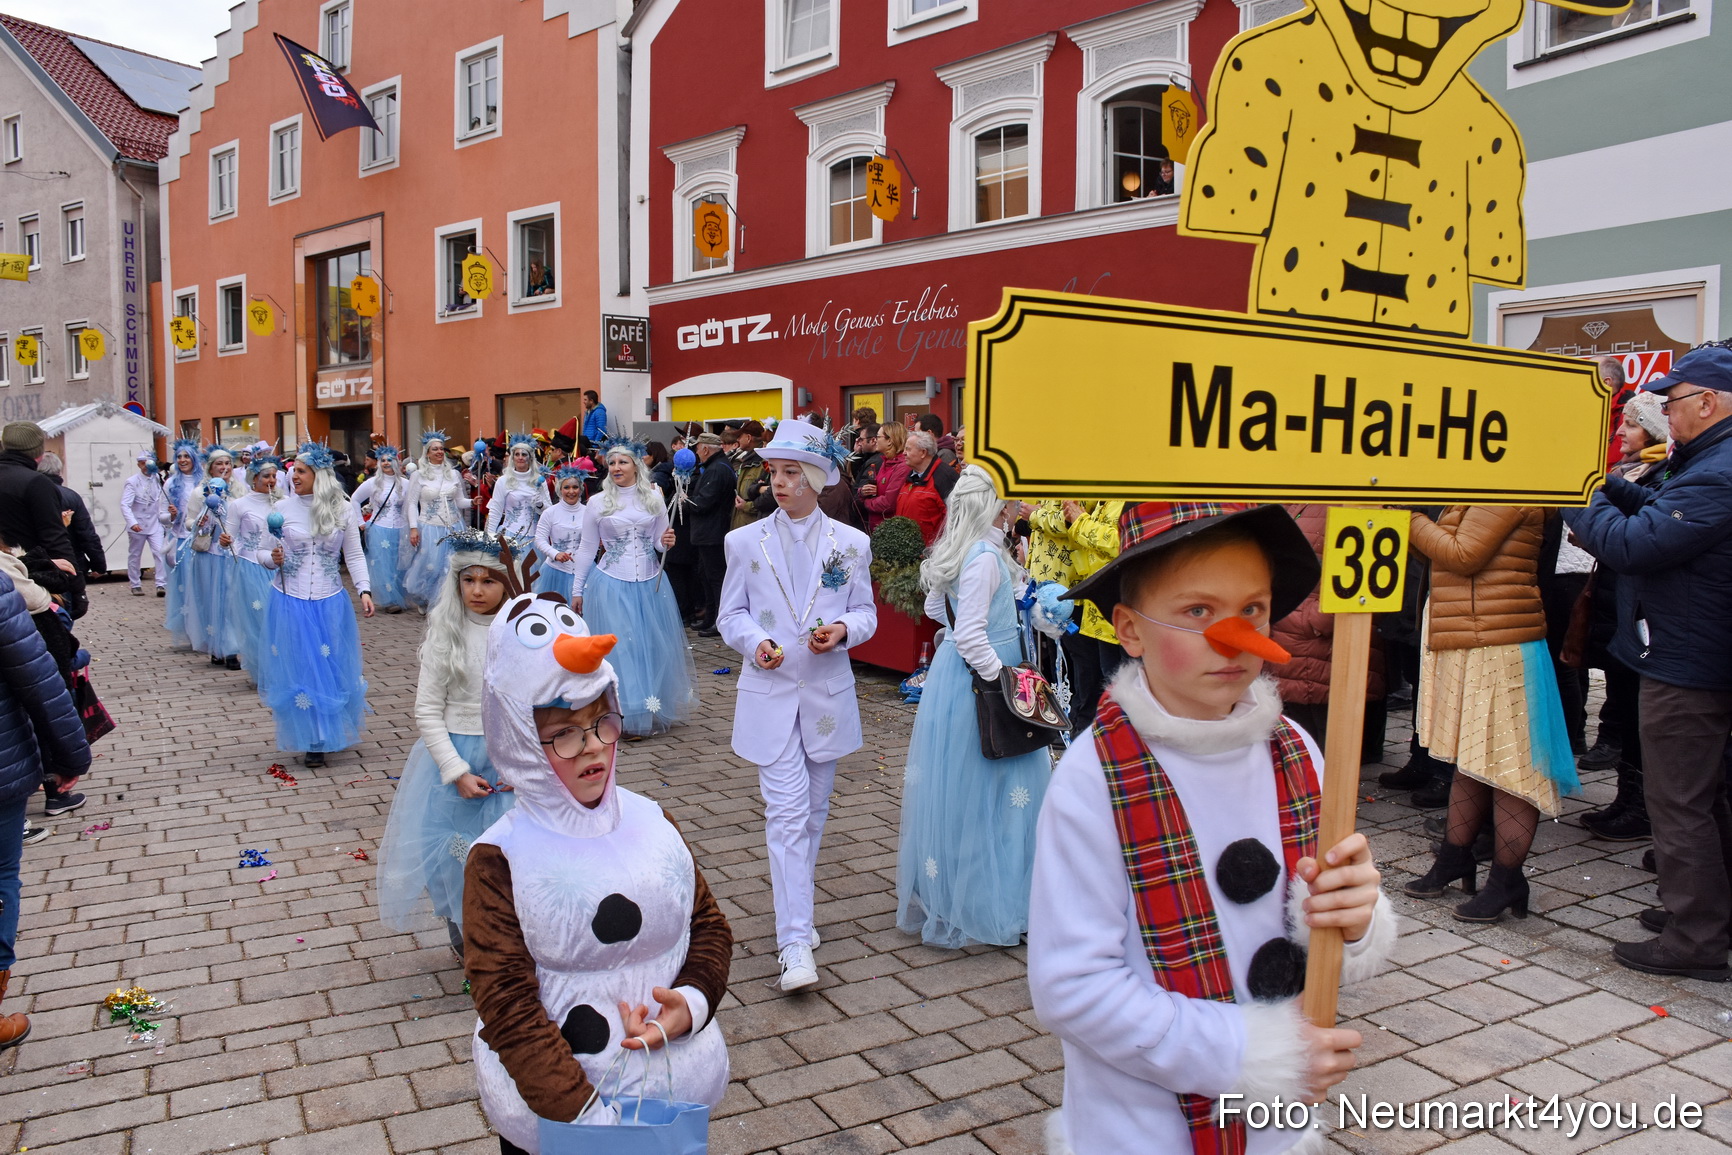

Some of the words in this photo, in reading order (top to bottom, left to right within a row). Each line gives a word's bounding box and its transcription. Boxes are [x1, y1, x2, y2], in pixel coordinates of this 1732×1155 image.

[124, 222, 136, 293] UHREN
[610, 323, 644, 342] CAFÉ
[784, 300, 832, 340] Mode
[835, 308, 884, 343] Genuss
[892, 284, 959, 325] Erlebnis
[126, 303, 138, 401] SCHMUCK
[316, 376, 373, 399] GÖTZ
[1169, 361, 1508, 463] Ma-Hai-He
[1332, 526, 1401, 599] 38
